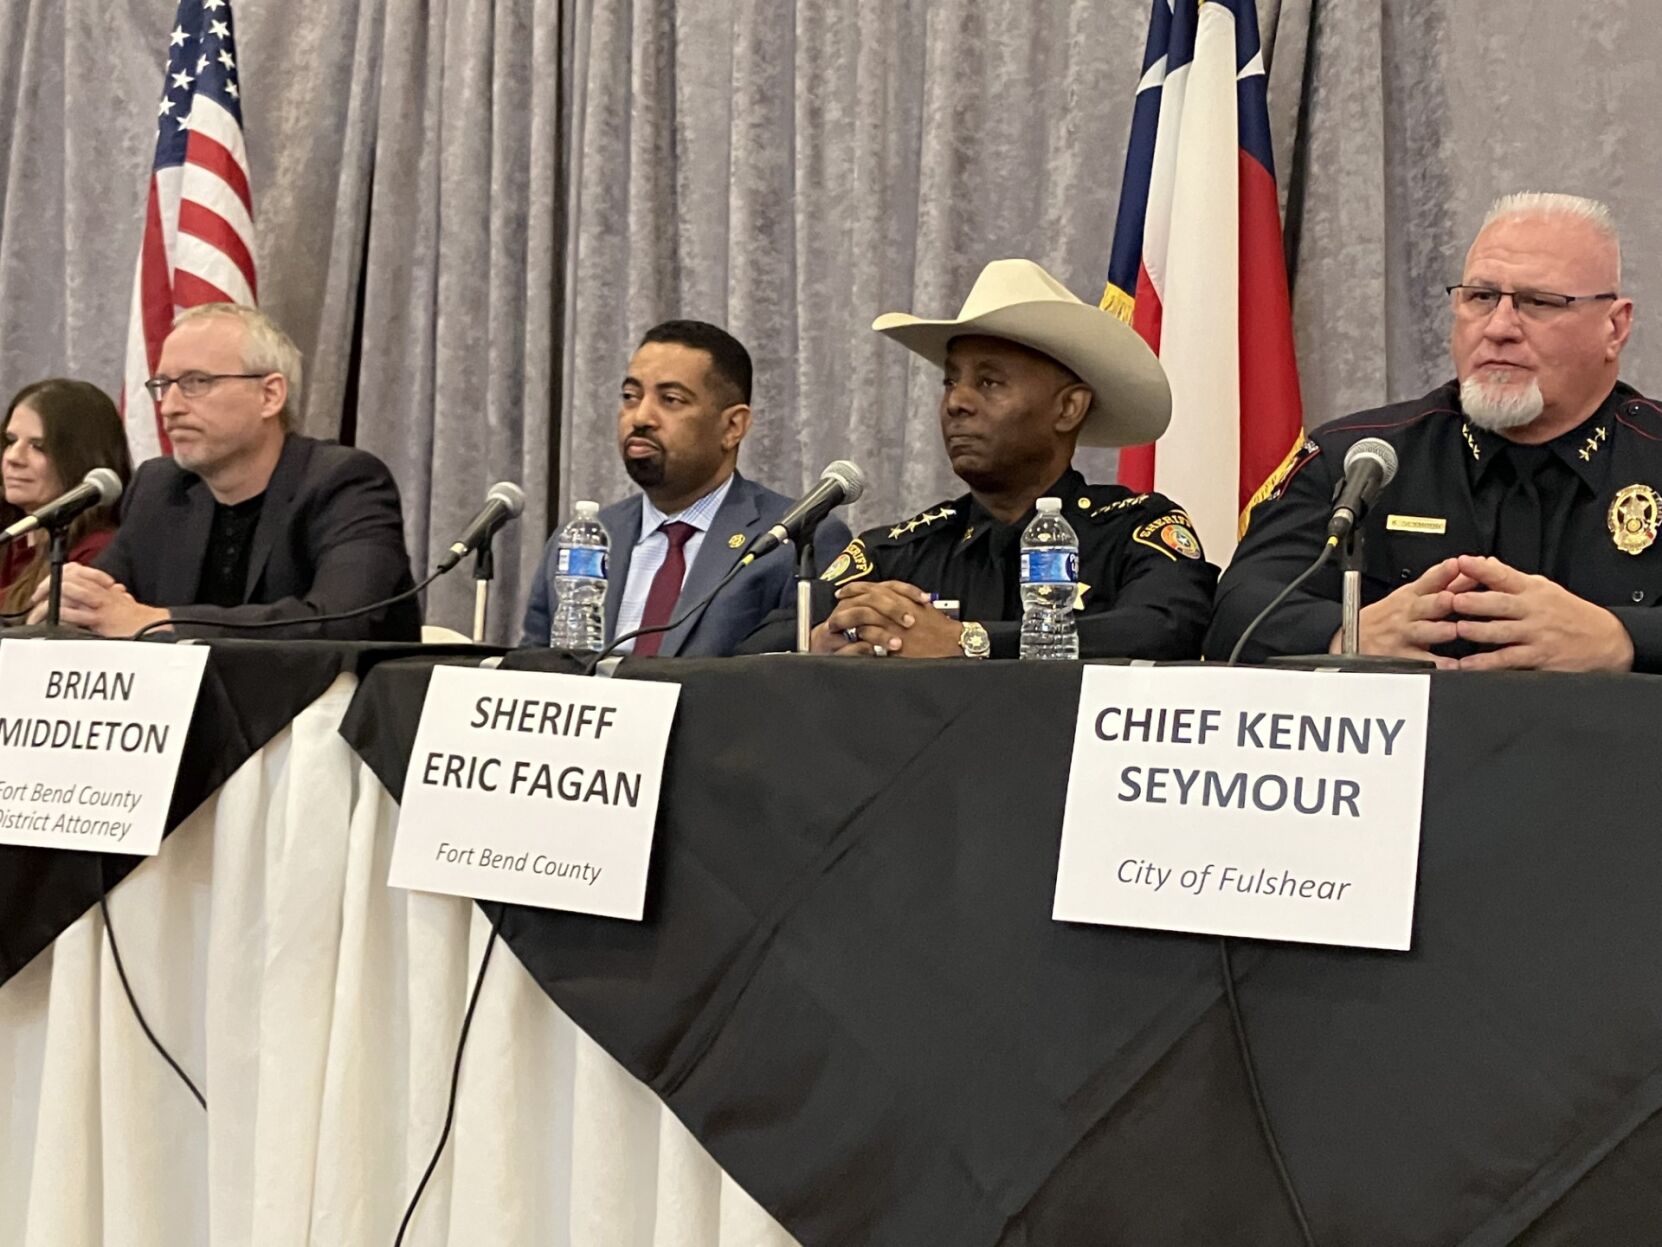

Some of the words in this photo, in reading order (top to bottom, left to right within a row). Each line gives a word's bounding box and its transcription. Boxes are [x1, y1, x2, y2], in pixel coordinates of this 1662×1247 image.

[45, 670, 135, 701] BRIAN
[0, 717, 169, 754] MIDDLETON
[470, 696, 617, 739] SHERIFF
[1094, 707, 1221, 745] CHIEF
[1237, 711, 1406, 756] KENNY
[30, 782, 76, 805] Bend
[78, 785, 143, 813] County
[422, 752, 502, 792] ERIC
[509, 761, 642, 808] FAGAN
[1117, 766, 1361, 817] SEYMOUR
[51, 813, 132, 842] Attorney
[435, 842, 475, 866] Fort
[478, 847, 529, 872] Bend
[532, 854, 602, 886] County
[1117, 858, 1172, 891] City
[1180, 863, 1215, 895] of
[1218, 866, 1352, 901] Fulshear
